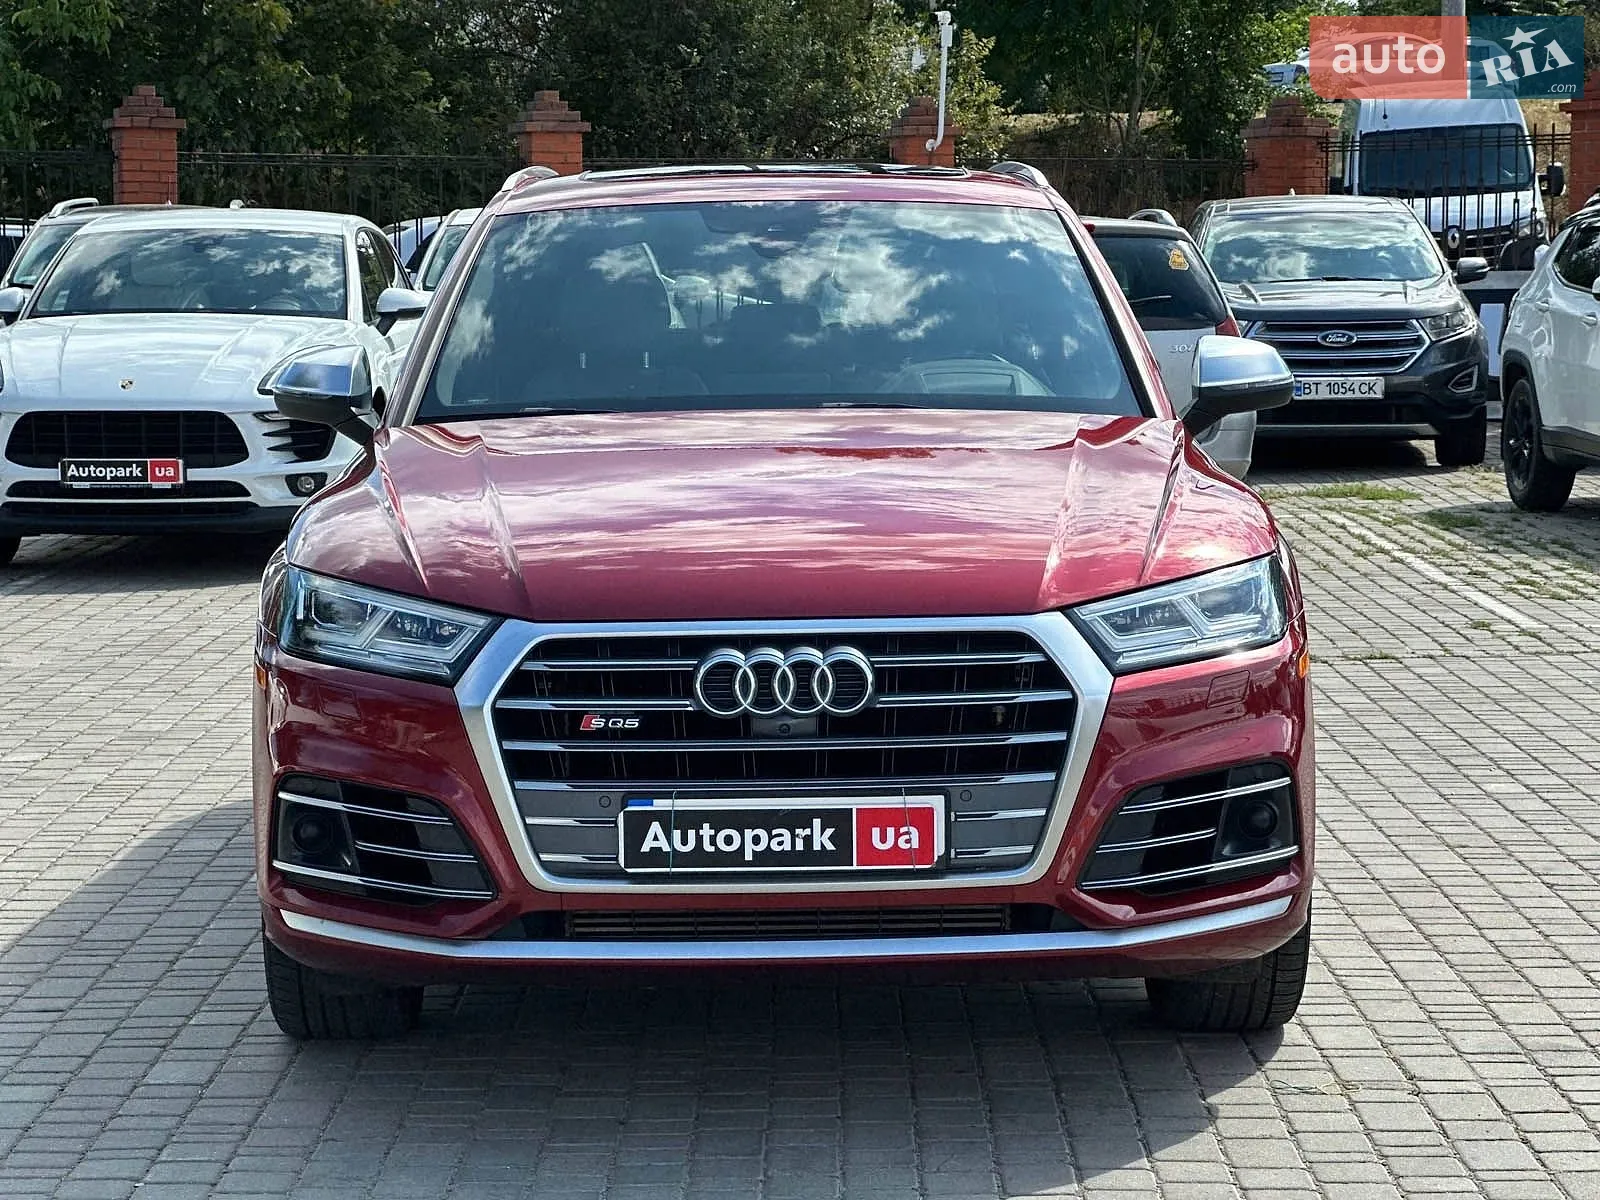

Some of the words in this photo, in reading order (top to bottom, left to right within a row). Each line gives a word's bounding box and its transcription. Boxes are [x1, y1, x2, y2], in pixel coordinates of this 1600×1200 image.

[1302, 382, 1321, 396] BT
[1326, 381, 1356, 395] 1054
[1358, 381, 1378, 395] CK
[66, 463, 143, 481] Autopark
[155, 466, 175, 477] ua
[640, 817, 836, 861] Autopark
[871, 825, 920, 850] ua
